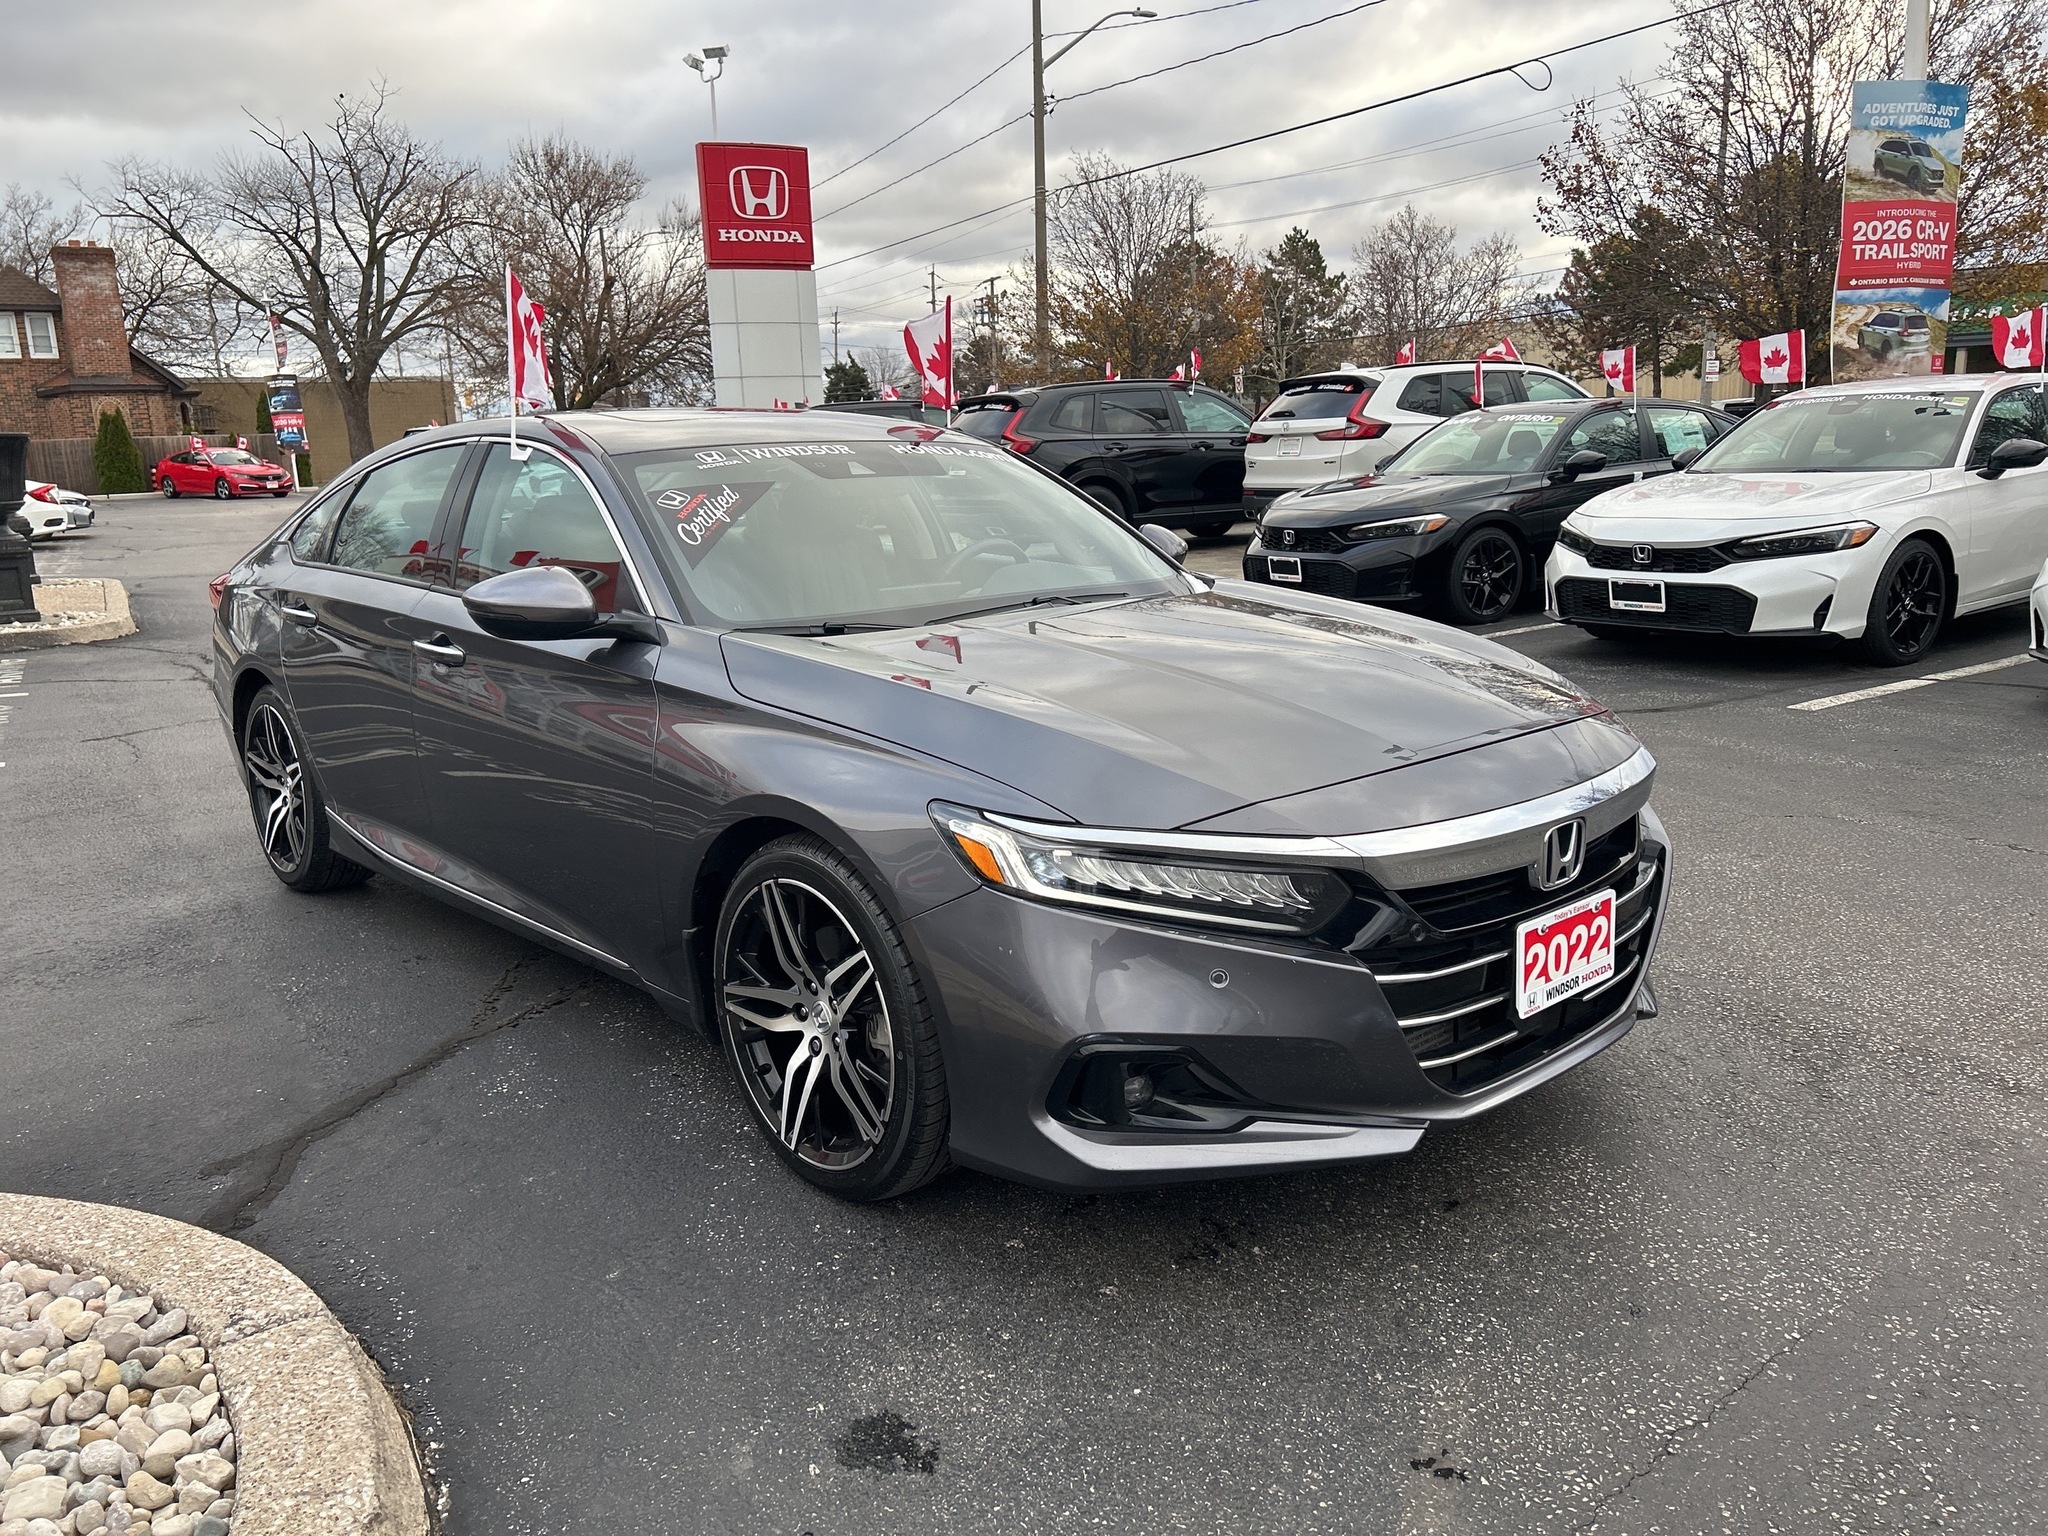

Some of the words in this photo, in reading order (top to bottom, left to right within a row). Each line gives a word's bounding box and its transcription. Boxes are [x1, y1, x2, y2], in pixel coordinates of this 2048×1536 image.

[1862, 102, 1937, 114] ADVENTURES
[1937, 105, 1960, 117] JUST
[1870, 115, 1897, 126] GOT
[1898, 115, 1952, 129] UPGRADED.
[1876, 208, 1926, 218] INTRODUCING
[1927, 210, 1937, 218] THE
[718, 228, 806, 243] HONDA
[1852, 219, 1913, 241] 2026
[1916, 219, 1950, 241] CR-V
[1858, 277, 1888, 285] ONTARIO
[1889, 276, 1909, 284] BUILT.
[1798, 396, 1846, 406] WINDSOR
[1862, 394, 1945, 403] HONDA.com
[1497, 414, 1554, 422] ONTARIO
[741, 444, 856, 460] WINDSOR
[697, 459, 742, 470] HONDA
[677, 492, 708, 519] HONDA
[677, 484, 740, 545] Certified
[1553, 908, 1573, 921] Today's
[1525, 915, 1609, 993] 2022
[1545, 976, 1580, 1001] WINDSOR
[1581, 963, 1613, 984] HONDA
[1523, 1005, 1541, 1016] HONDA
